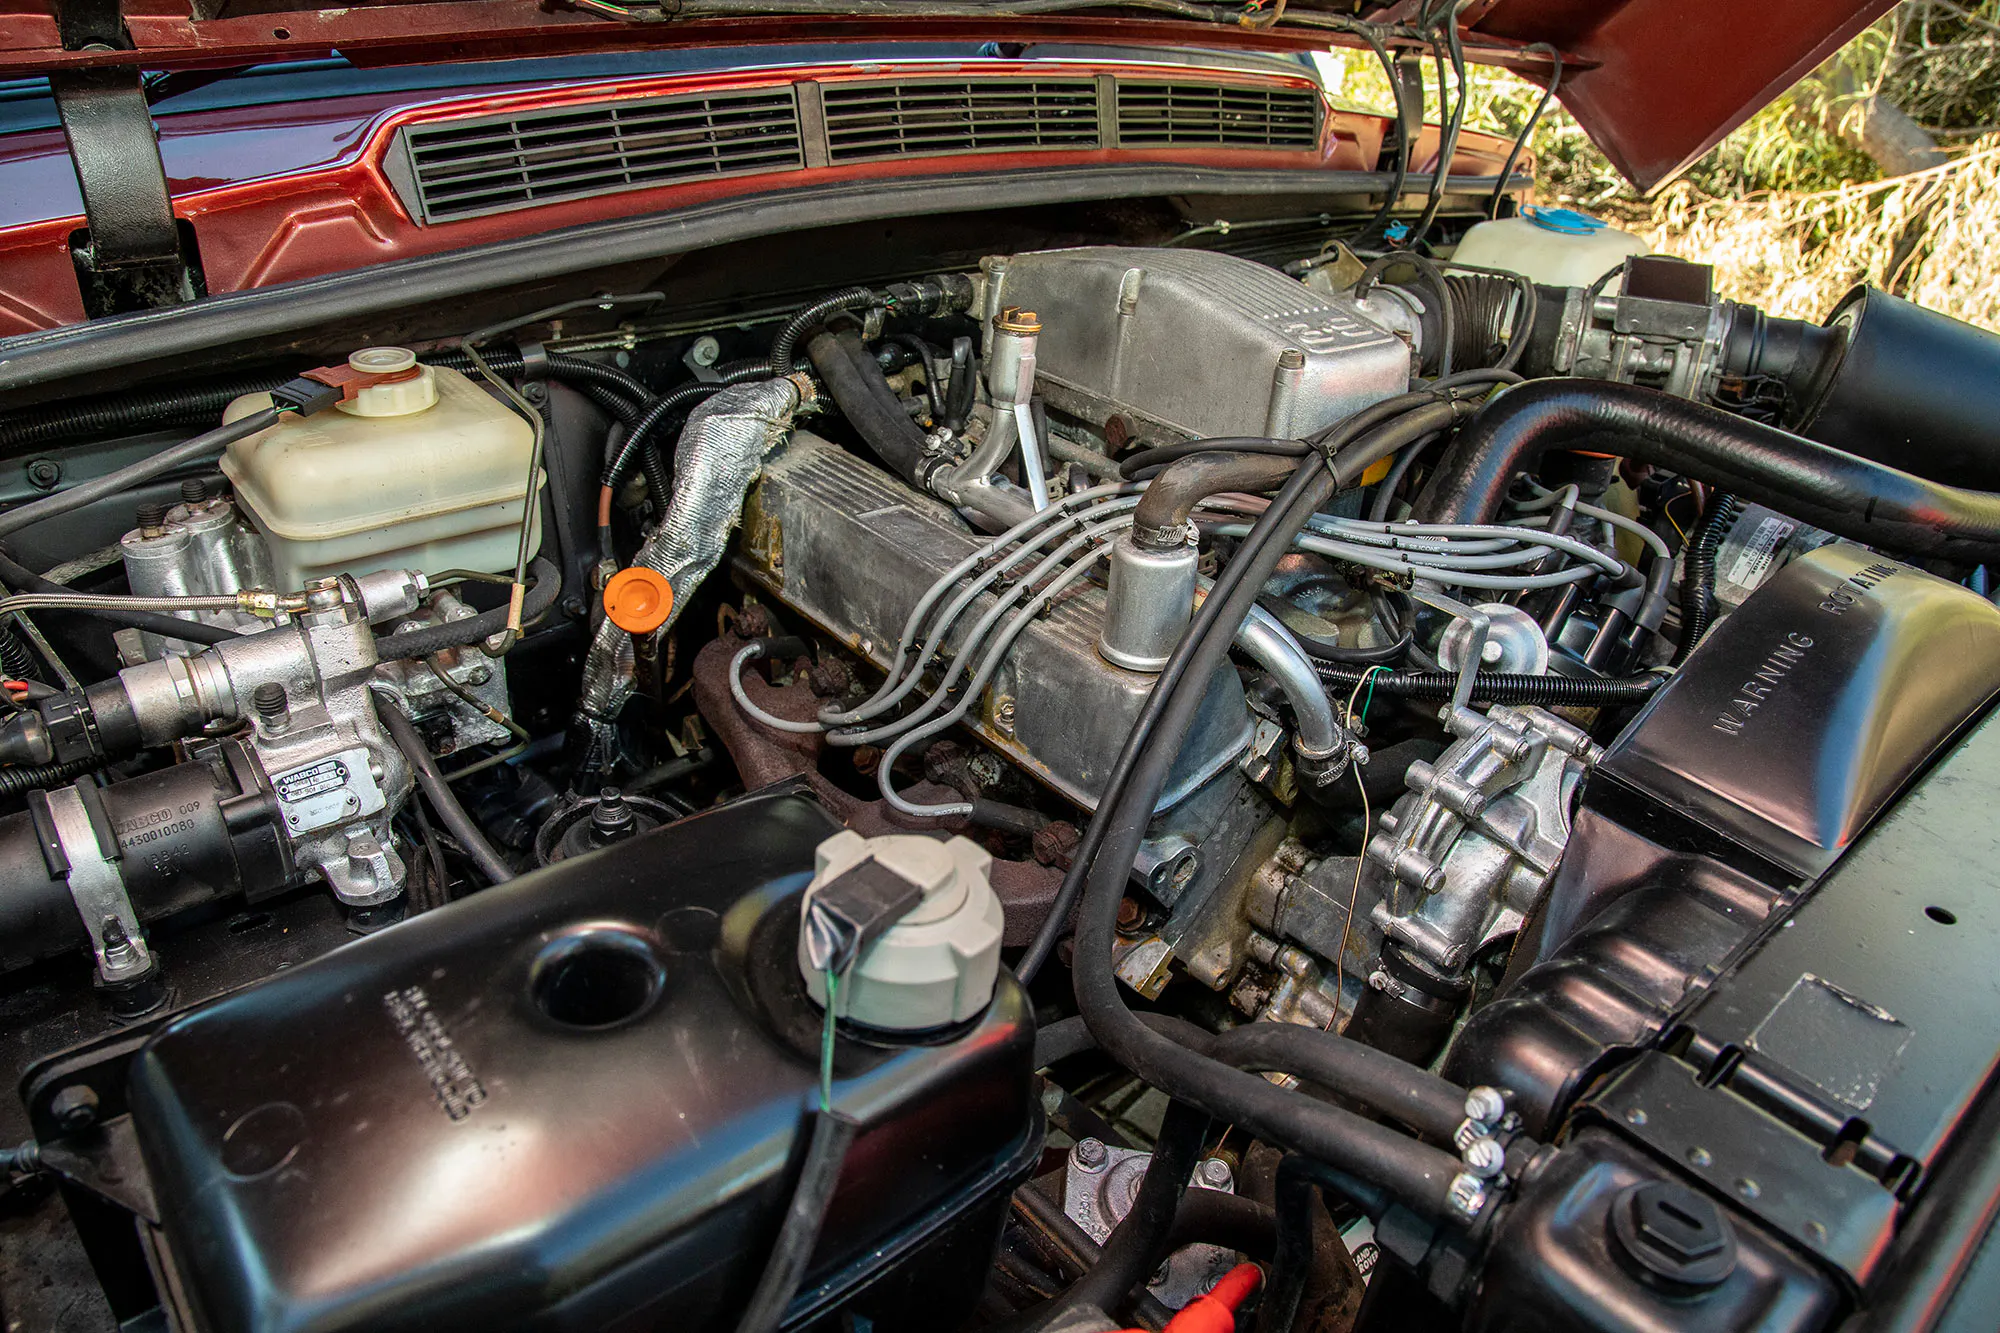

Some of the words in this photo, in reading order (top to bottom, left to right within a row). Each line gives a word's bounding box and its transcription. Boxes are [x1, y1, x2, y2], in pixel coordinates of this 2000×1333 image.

[1343, 532, 1390, 547] SUPPRESSION
[1712, 632, 1814, 736] WARNING
[283, 766, 320, 784] WABCO
[178, 800, 201, 816] 009
[121, 818, 195, 850] 4430010080
